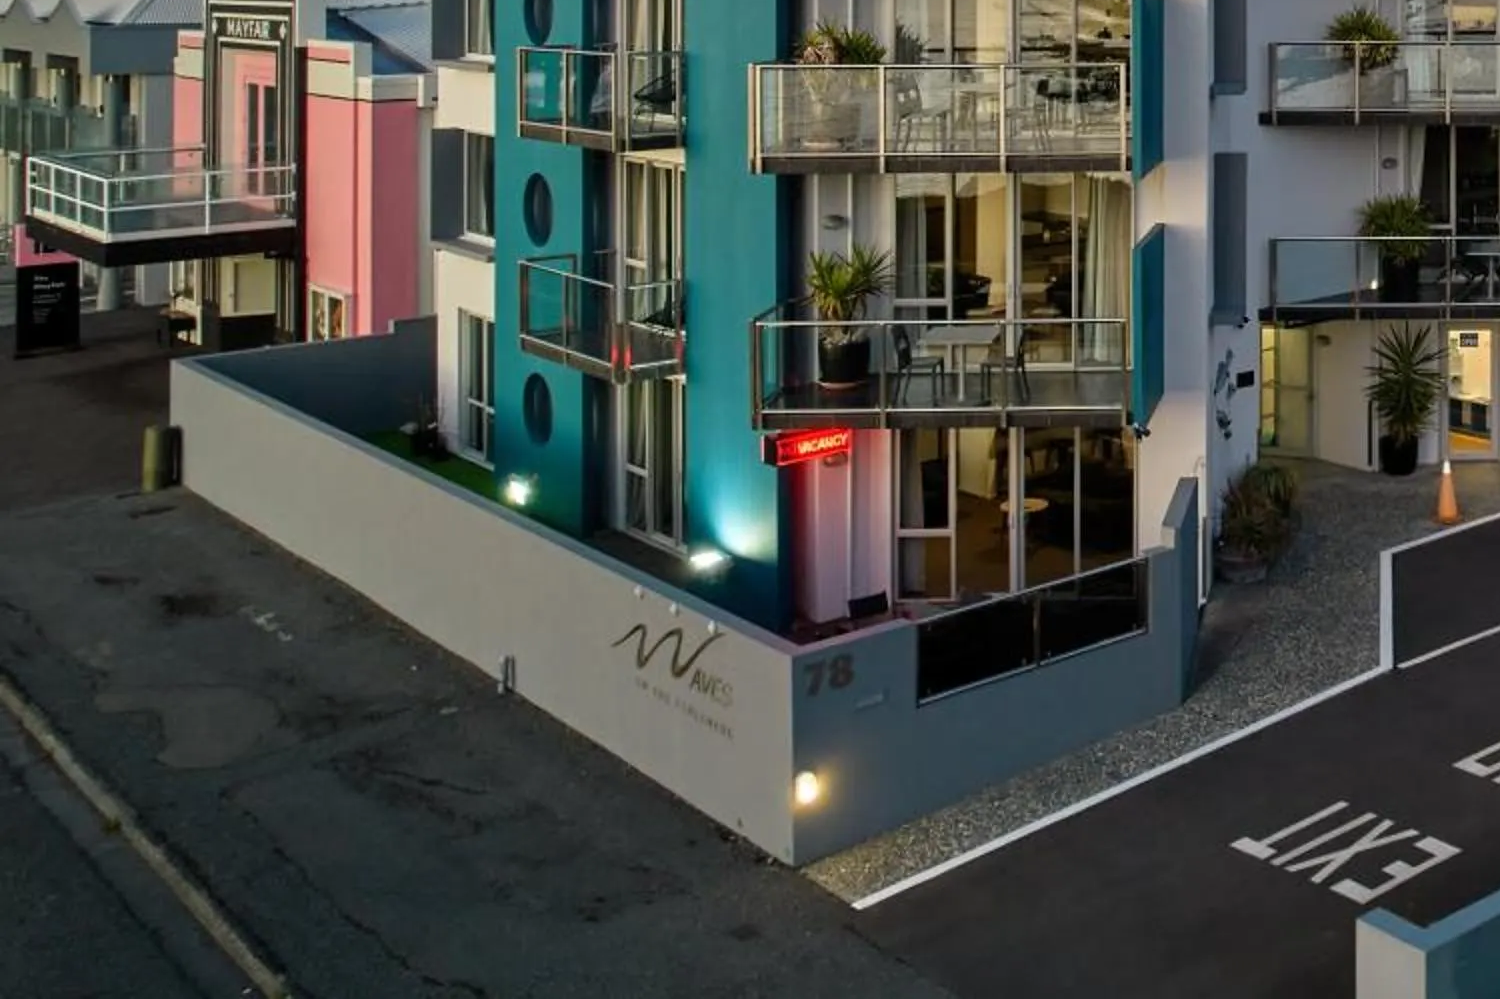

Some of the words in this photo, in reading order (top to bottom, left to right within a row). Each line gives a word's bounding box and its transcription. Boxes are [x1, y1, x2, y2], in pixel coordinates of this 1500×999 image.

[797, 433, 849, 454] VACANCY
[803, 654, 855, 697] 78
[1229, 800, 1463, 904] EXIT
